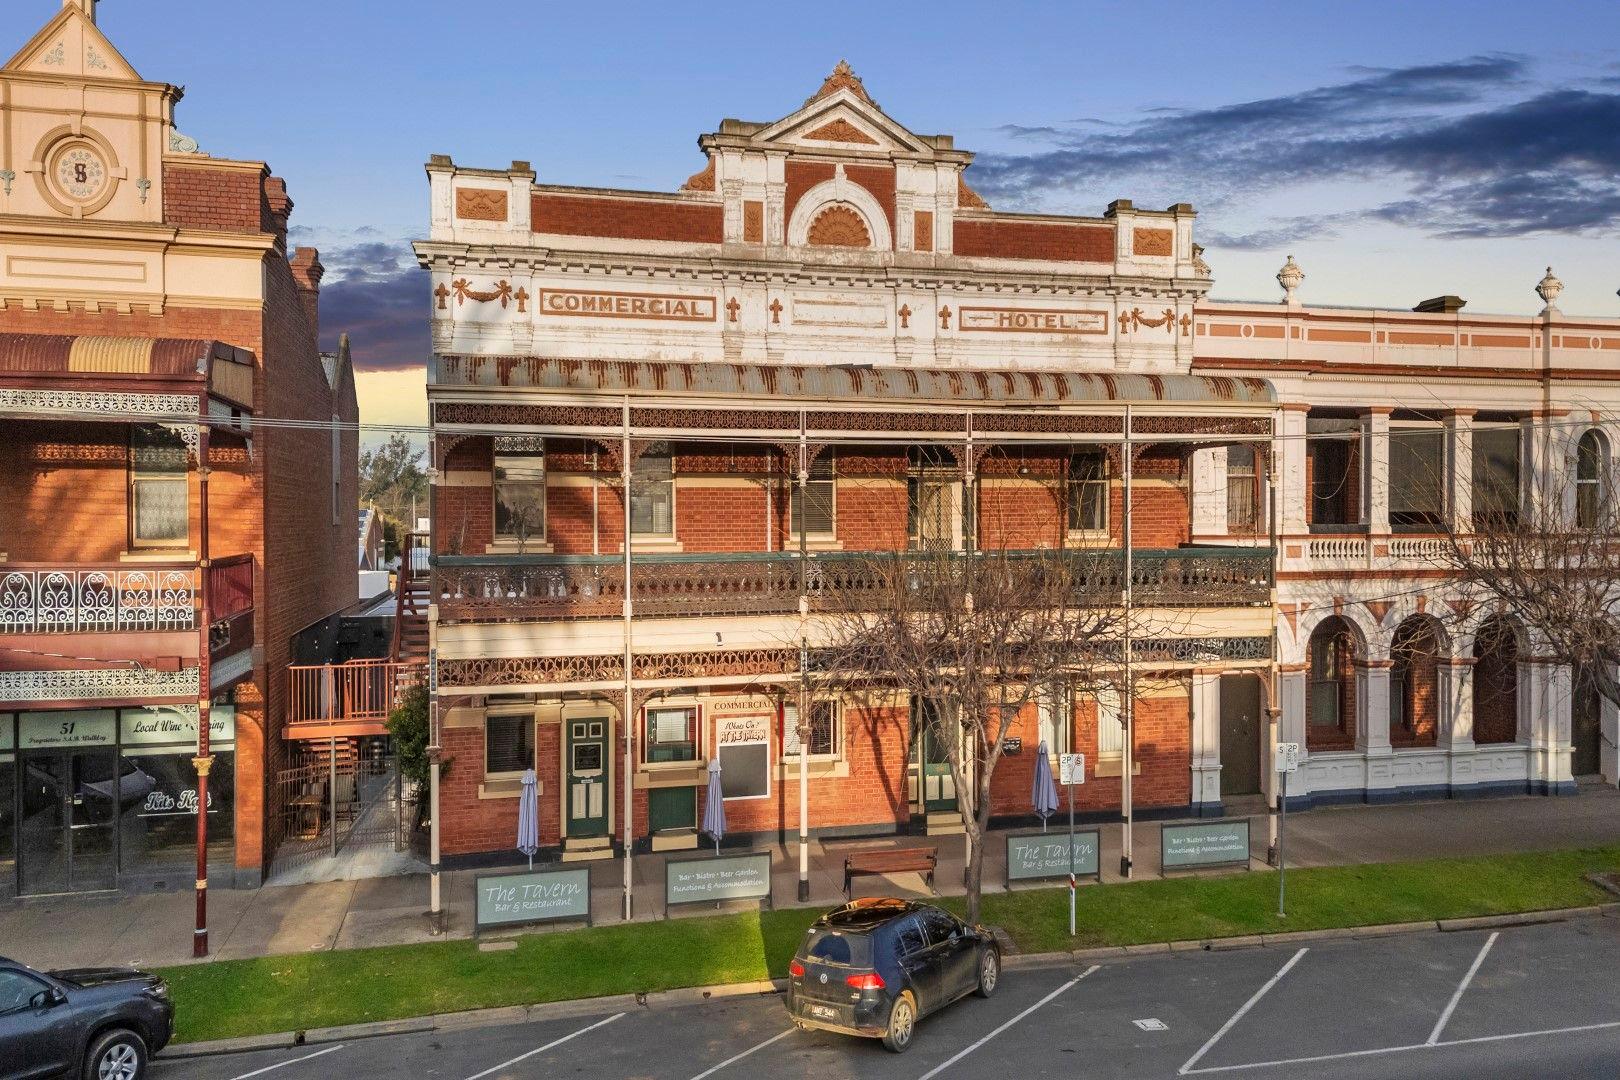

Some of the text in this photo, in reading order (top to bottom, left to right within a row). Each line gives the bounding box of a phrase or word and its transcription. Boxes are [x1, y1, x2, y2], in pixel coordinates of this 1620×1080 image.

[549, 294, 705, 316] COMMERCIAL
[60, 722, 75, 735] 51
[133, 721, 158, 733] Local
[160, 719, 182, 732] Wine
[1288, 744, 1298, 752] 2P
[1061, 756, 1072, 764] 2P
[1015, 844, 1040, 860] The
[1022, 860, 1036, 869] Bar
[486, 883, 581, 902] The Tavern
[495, 903, 511, 912] Bar
[523, 899, 571, 910] Restaurant
